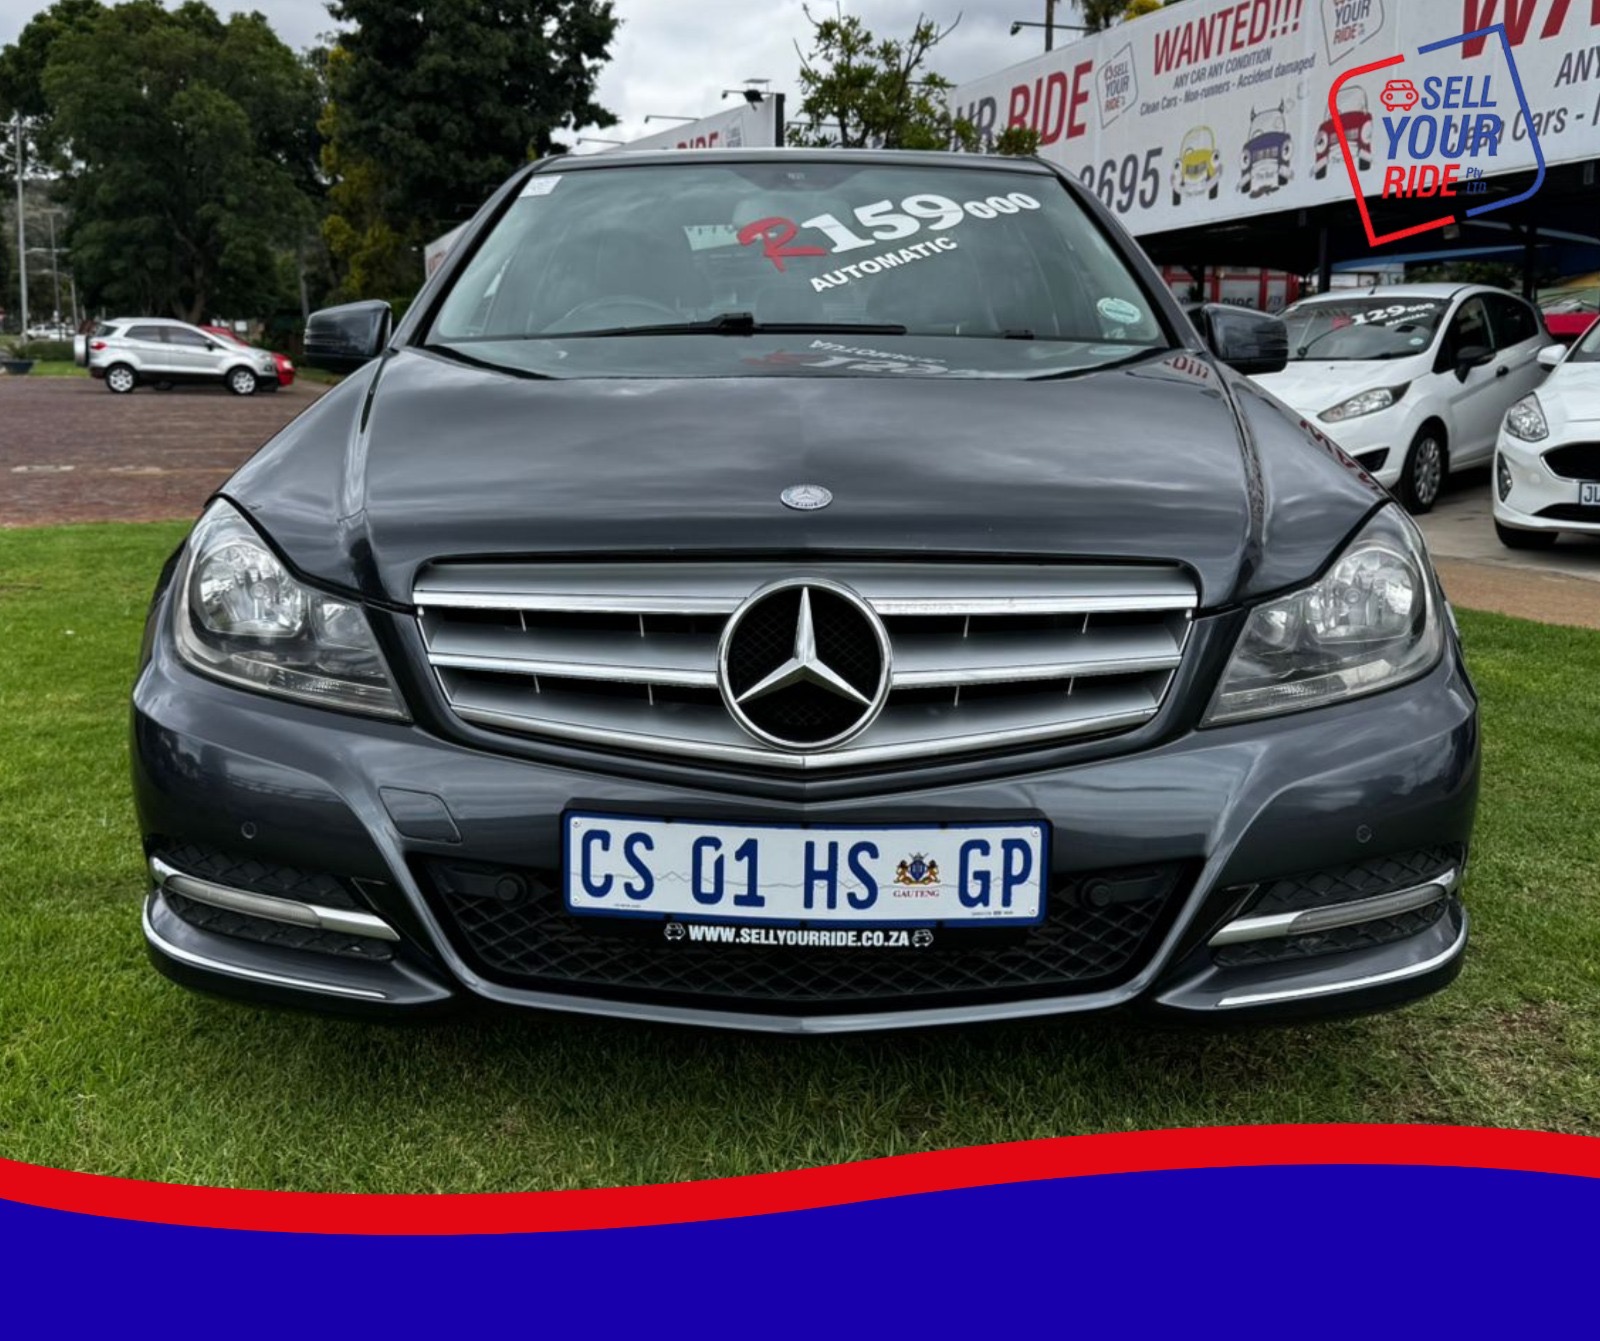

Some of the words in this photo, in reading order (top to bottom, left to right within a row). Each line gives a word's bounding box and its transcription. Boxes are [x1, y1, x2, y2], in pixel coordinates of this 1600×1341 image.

[1154, 0, 1304, 76] WANTED!!!
[1335, 0, 1371, 27] YOUR
[1105, 75, 1130, 98] YOUR
[1161, 96, 1178, 110] Cars
[1184, 80, 1231, 104] Non-runners
[1237, 65, 1274, 90] Accident
[1274, 52, 1317, 79] damaged
[1173, 72, 1190, 90] ANY
[1190, 67, 1207, 85] CAR
[1207, 61, 1225, 79] ANY
[1225, 46, 1273, 74] CONDITION
[1007, 59, 1094, 147] RIDE
[810, 237, 957, 292] AUTOMATIC
[581, 829, 655, 901] CS
[692, 836, 765, 907] 01
[803, 840, 880, 910] HS
[958, 838, 1032, 908] GP
[893, 889, 940, 898] GAUTENG
[688, 924, 910, 947] WWW.SELLYOURRIDE.CO.ZA
